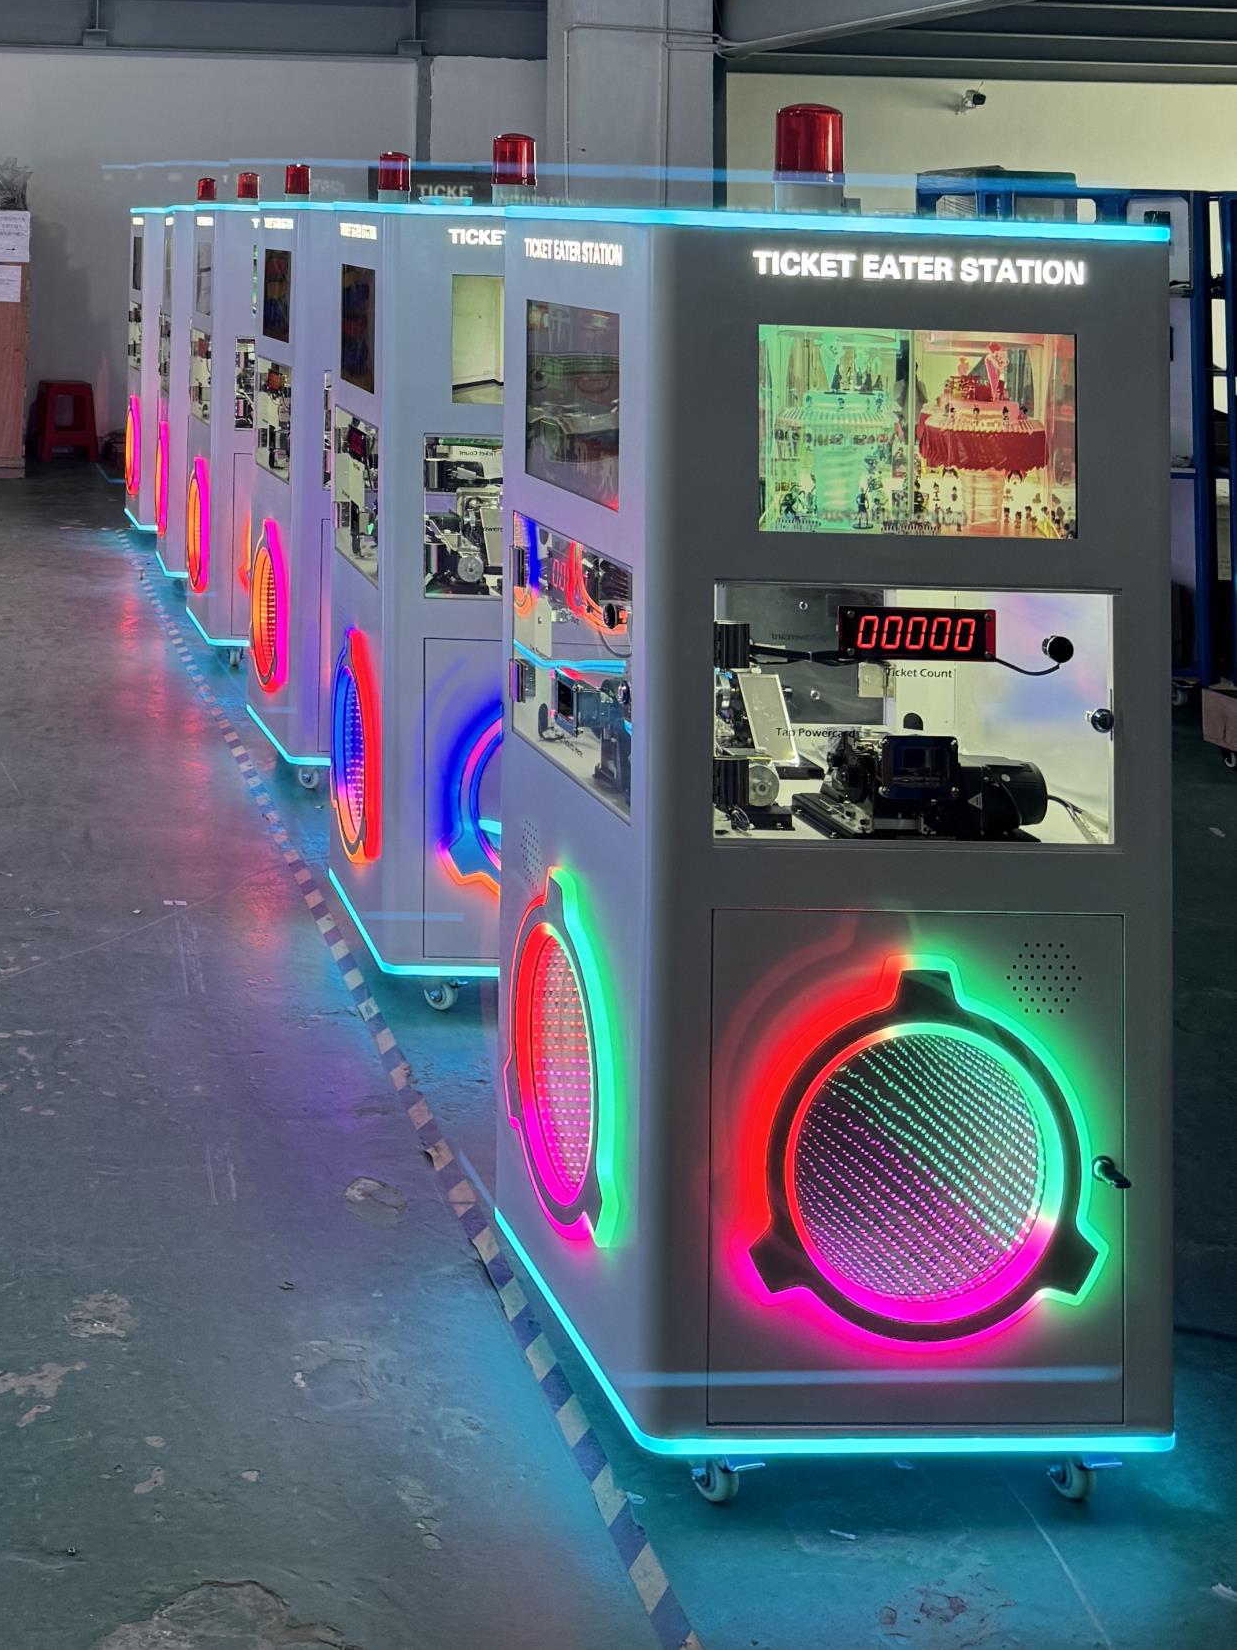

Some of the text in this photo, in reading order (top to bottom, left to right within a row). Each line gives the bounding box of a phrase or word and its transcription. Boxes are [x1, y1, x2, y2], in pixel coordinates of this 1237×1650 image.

[524, 237, 623, 266] TICKET EATER STATION
[752, 250, 1085, 286] TICKET EATER STATION
[856, 614, 976, 652] 00000
[886, 668, 953, 678] Ticket Count
